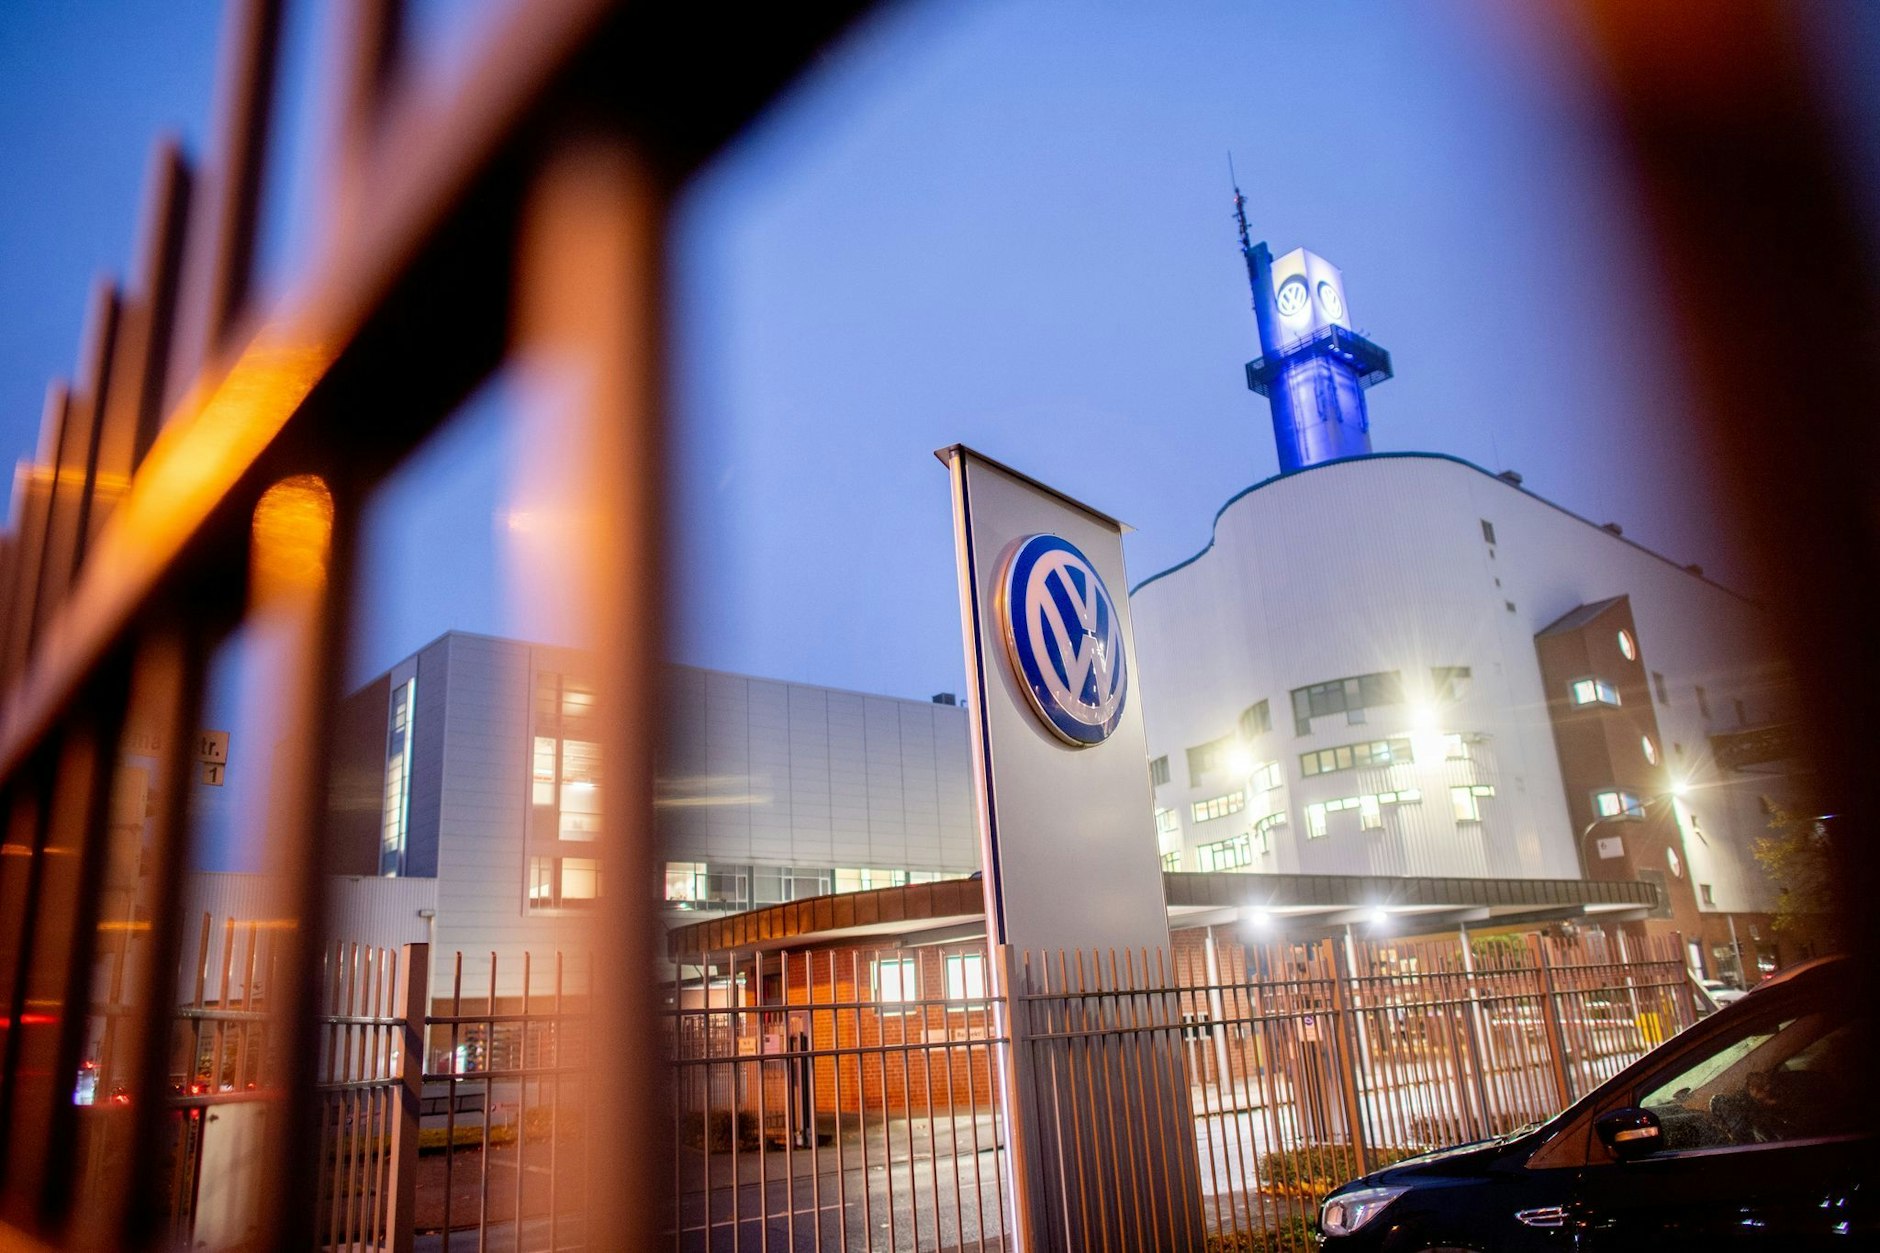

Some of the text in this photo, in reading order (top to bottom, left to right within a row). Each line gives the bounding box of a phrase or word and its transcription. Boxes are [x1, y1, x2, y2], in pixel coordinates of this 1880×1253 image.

[1278, 283, 1307, 315] VW
[1024, 547, 1125, 726] VW
[209, 767, 217, 783] 1
